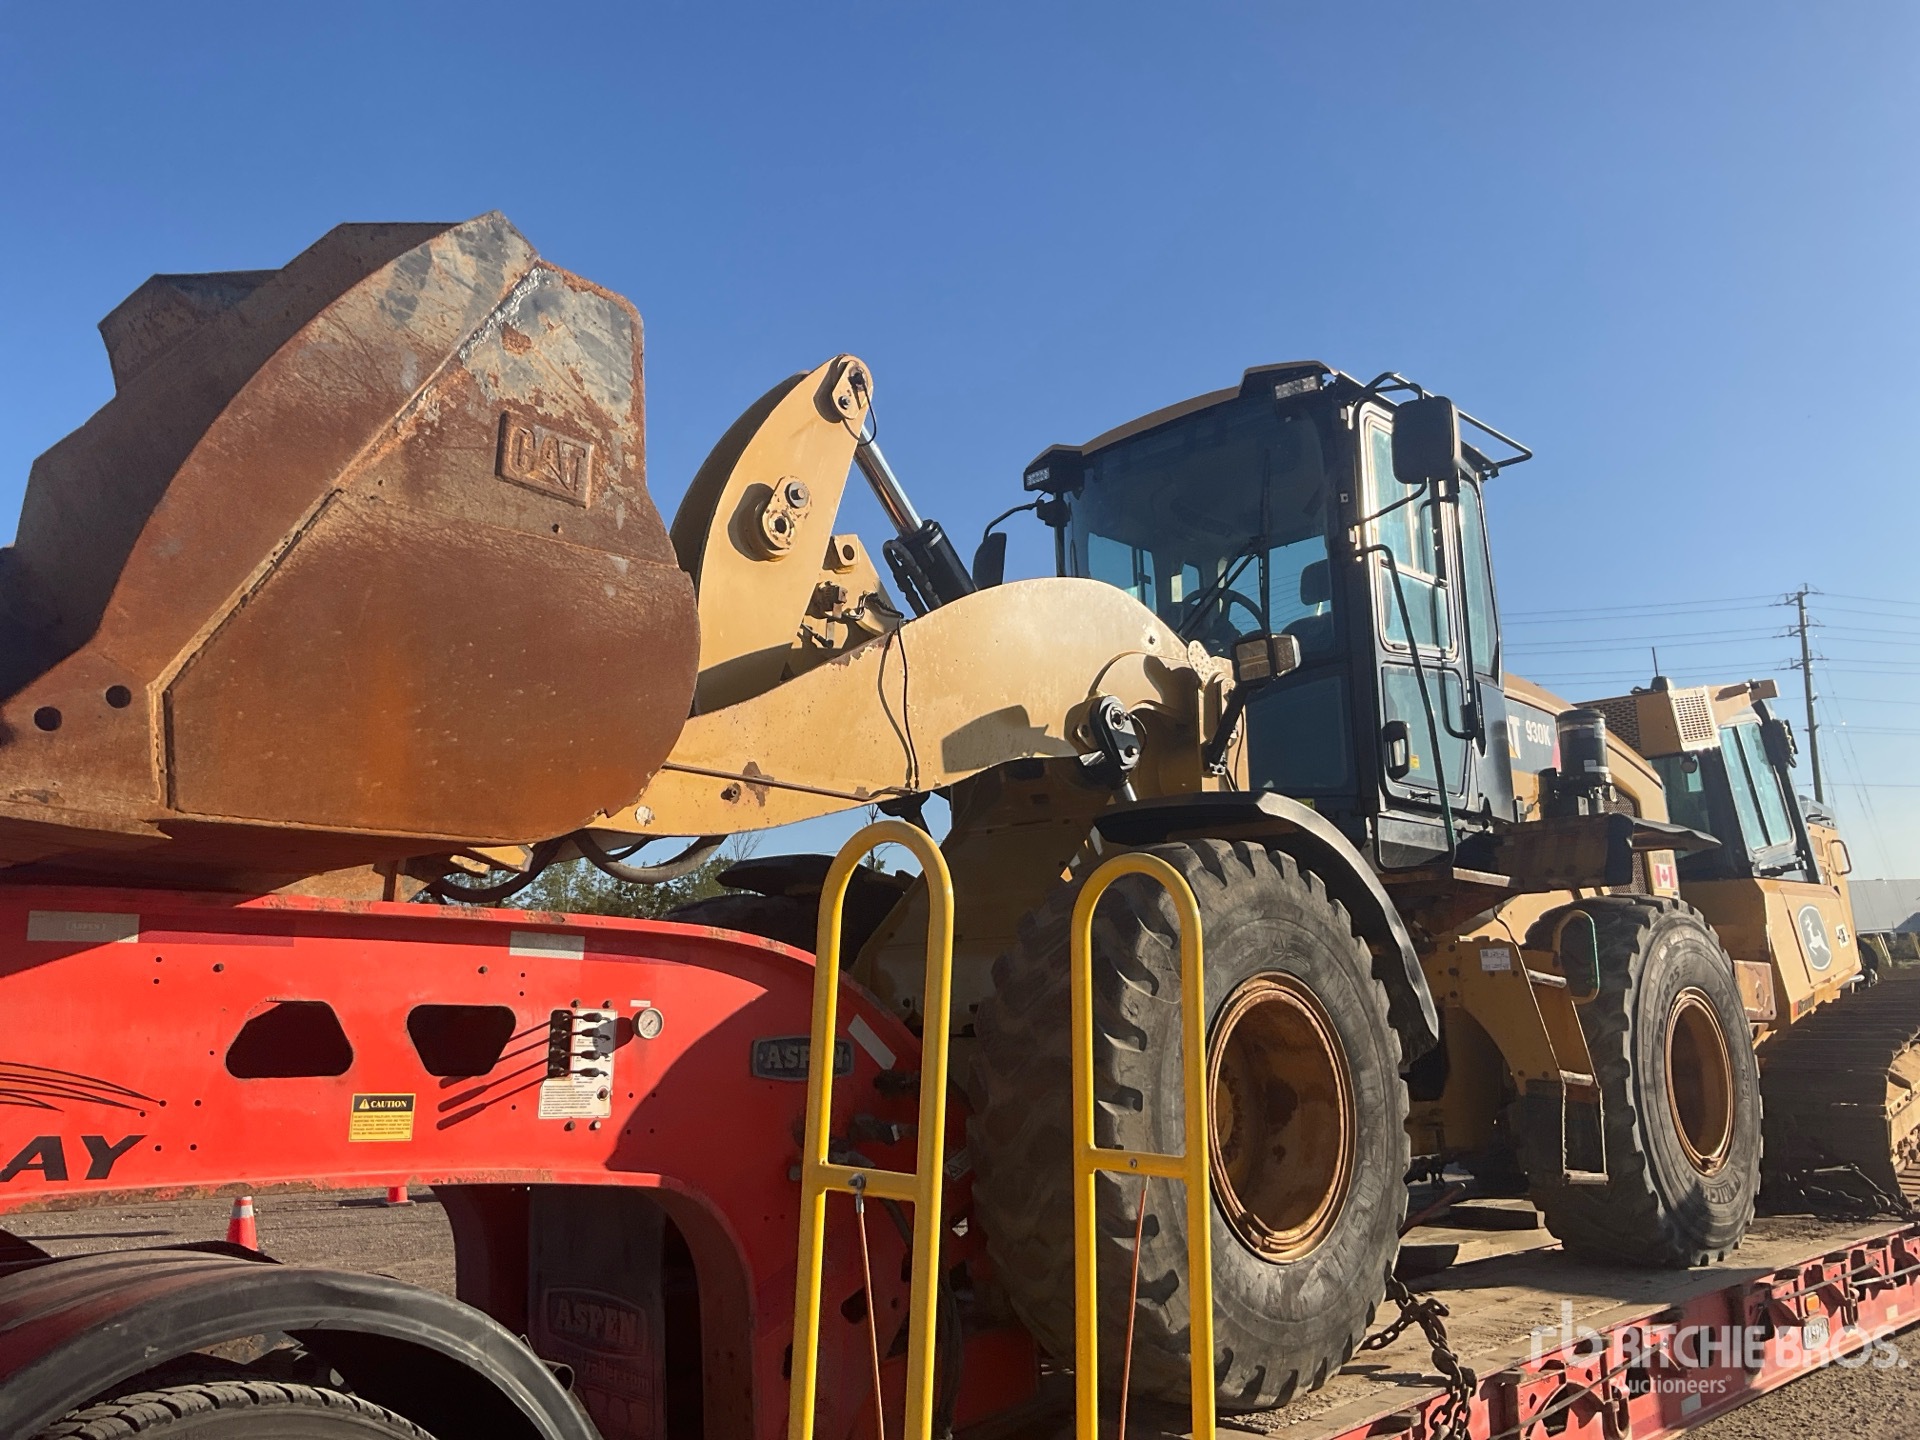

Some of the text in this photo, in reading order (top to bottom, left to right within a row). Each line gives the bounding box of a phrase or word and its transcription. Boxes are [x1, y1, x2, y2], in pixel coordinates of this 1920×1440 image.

[506, 424, 586, 495] CAT
[1525, 720, 1551, 747] 930K
[370, 1100, 408, 1108] CAUTION
[553, 1297, 638, 1346] ASPEN
